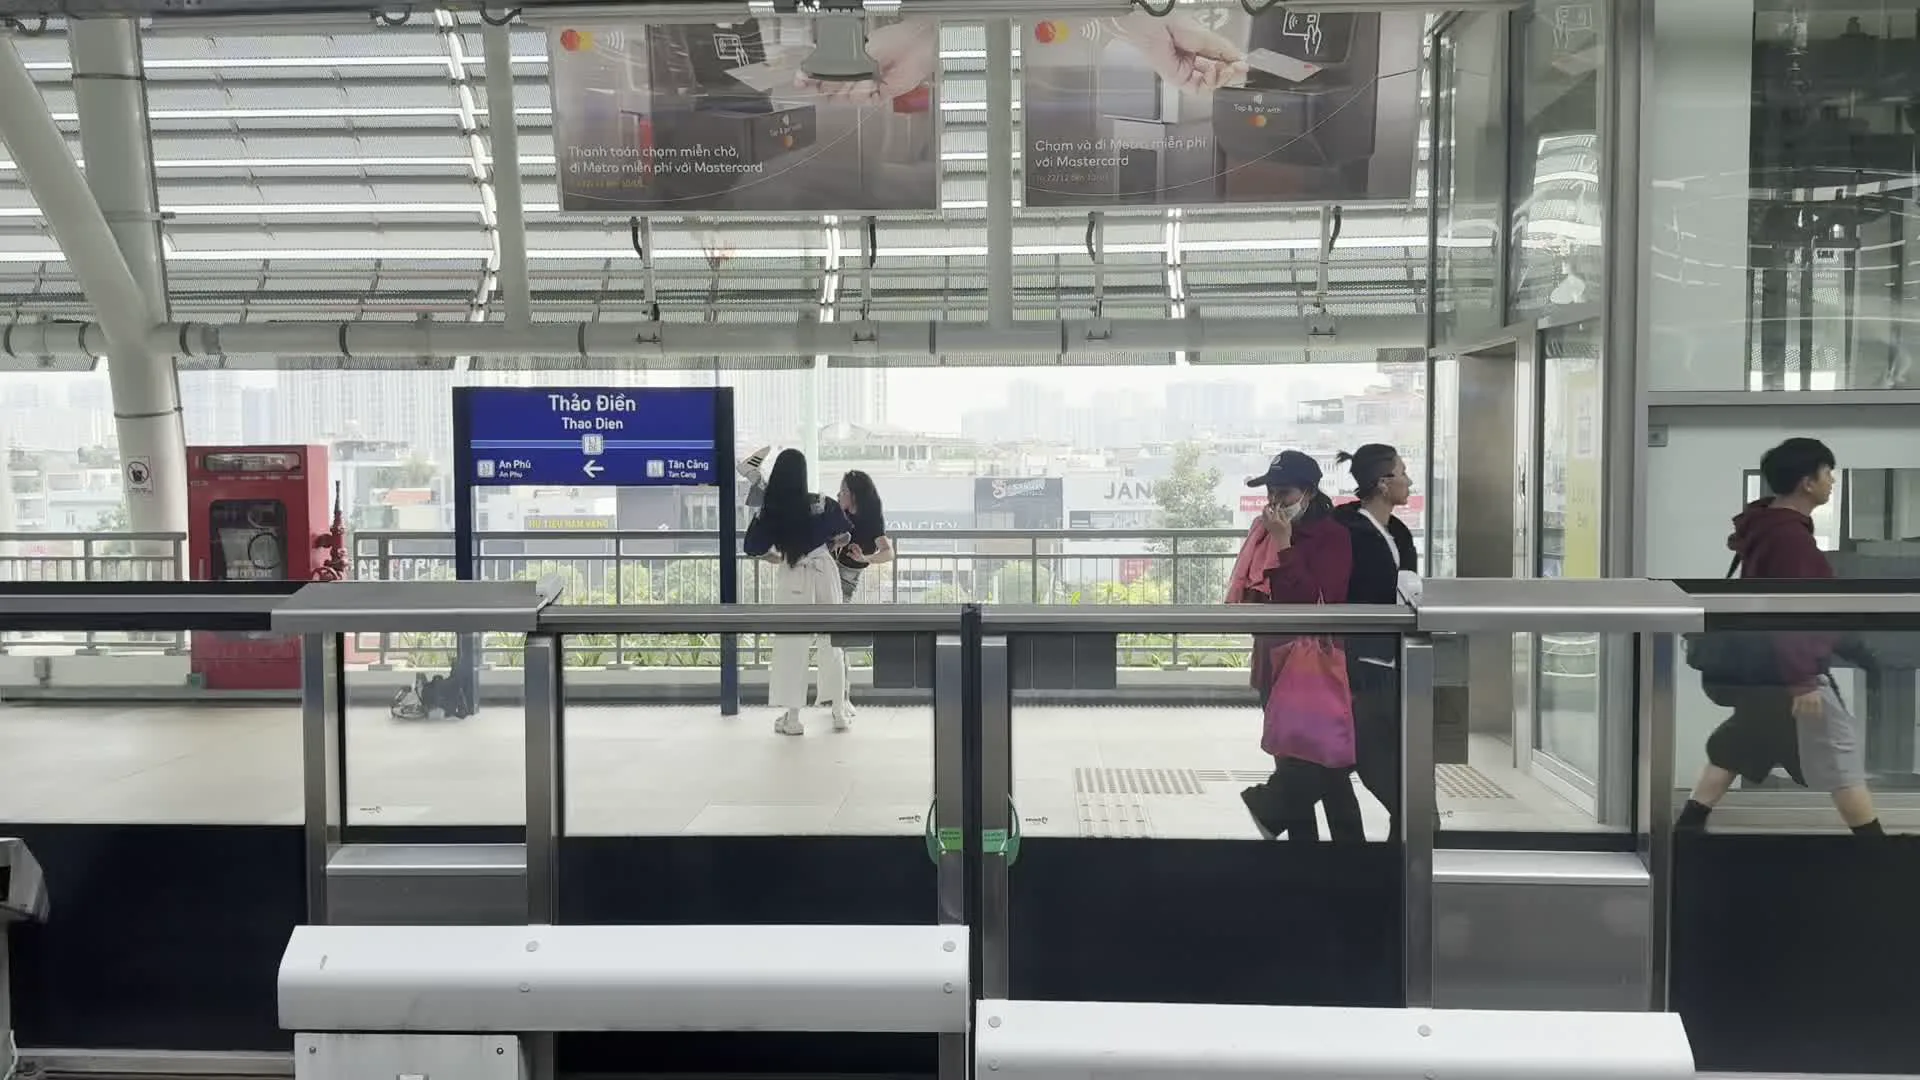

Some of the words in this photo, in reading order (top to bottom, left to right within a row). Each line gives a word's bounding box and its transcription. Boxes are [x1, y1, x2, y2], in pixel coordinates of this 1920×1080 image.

[567, 146, 607, 157] Thanh
[610, 146, 639, 157] toán
[642, 146, 677, 159] chạm
[680, 143, 711, 157] miễn
[1035, 140, 1073, 153] Chạm
[1077, 139, 1092, 151] và
[583, 161, 619, 173] Metro
[622, 160, 651, 173] miễn
[694, 160, 763, 173] Mastercard
[1056, 154, 1129, 168] Mastercard
[547, 392, 592, 412] Thảo
[596, 392, 637, 412] Điền
[561, 416, 592, 430] Thao
[595, 416, 624, 430] Dien
[498, 459, 512, 469] An
[513, 459, 532, 469] Phú
[667, 459, 685, 469] Tân
[686, 458, 709, 471] Cảng
